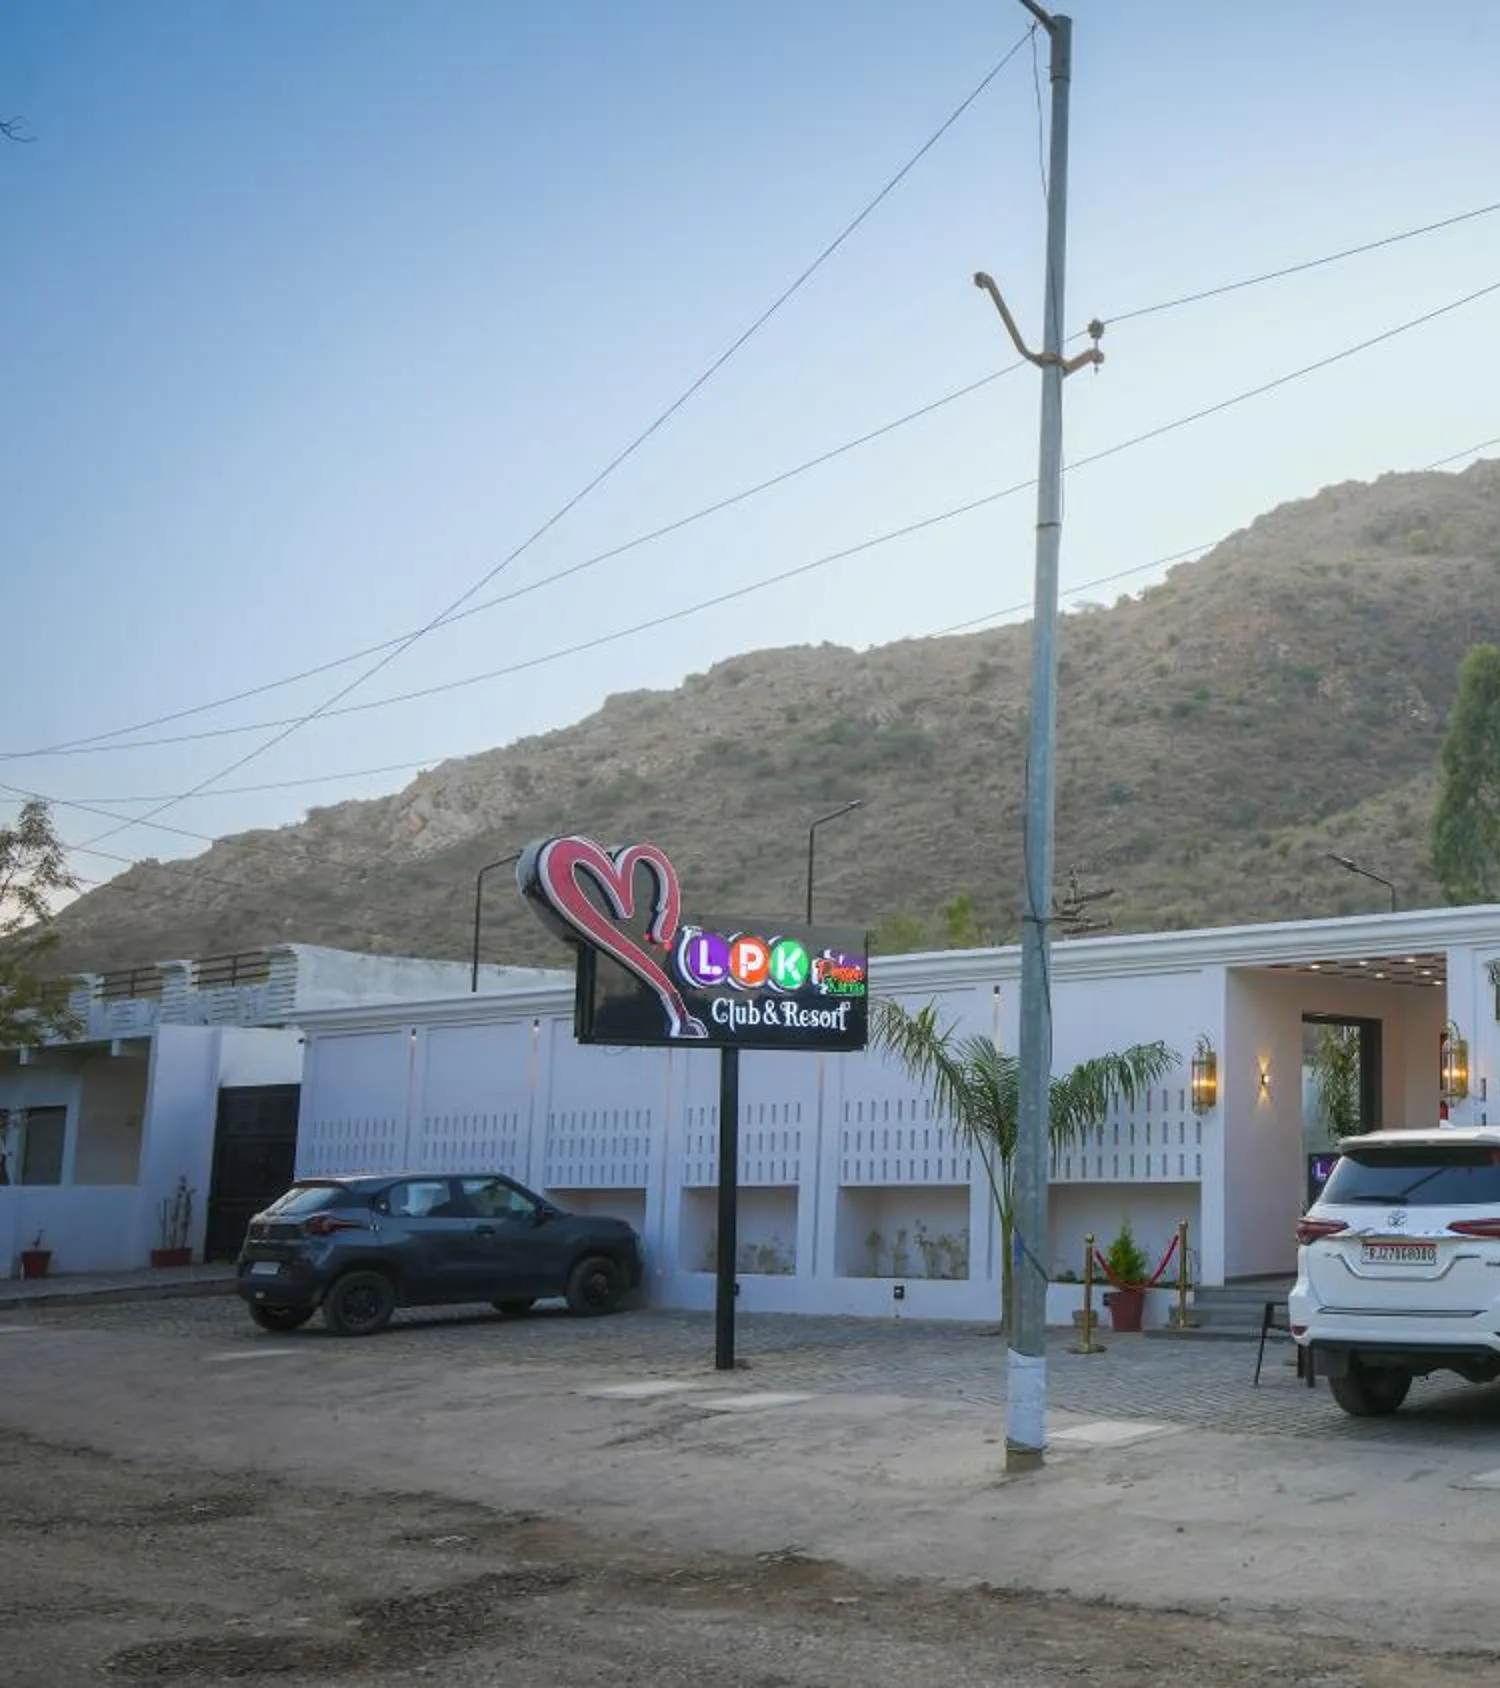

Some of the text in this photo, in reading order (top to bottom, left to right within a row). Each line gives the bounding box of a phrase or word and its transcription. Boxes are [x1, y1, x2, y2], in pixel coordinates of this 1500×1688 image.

[697, 937, 805, 983] LPK
[711, 997, 761, 1032] Club
[780, 1001, 851, 1031] Resort
